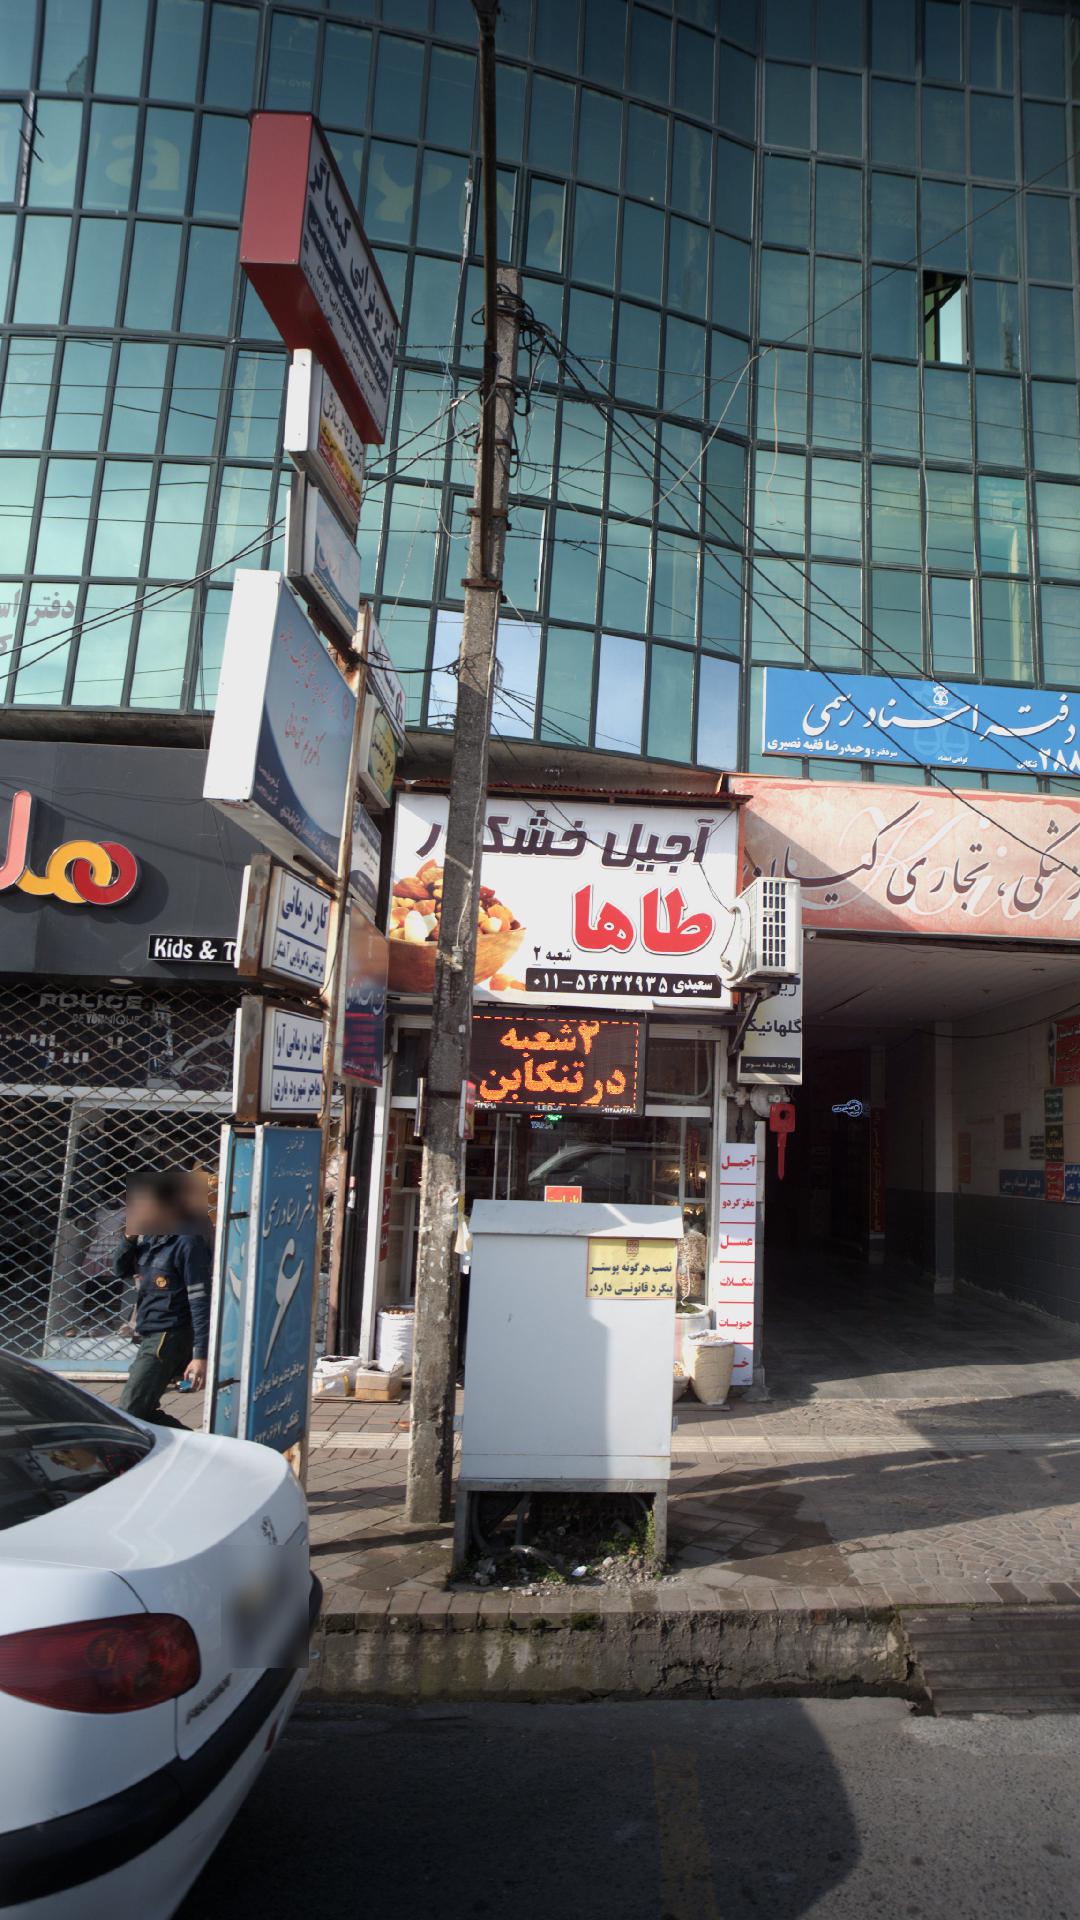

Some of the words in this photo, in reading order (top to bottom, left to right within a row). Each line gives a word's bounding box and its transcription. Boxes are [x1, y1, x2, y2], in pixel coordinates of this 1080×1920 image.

[27, 591, 75, 626] دفتر
[802, 692, 856, 737] رسمی
[863, 697, 979, 733] اسناد
[979, 693, 1076, 744] دفتر
[767, 737, 801, 751] نصیری
[415, 809, 588, 858] خشکر
[601, 818, 716, 873] آجیل
[886, 843, 990, 911] تجاری
[282, 886, 314, 929] درمانی
[314, 904, 328, 934] کار
[573, 884, 713, 953] طاها
[154, 938, 193, 959] Kids
[199, 940, 218, 960] &
[545, 948, 572, 965] شعبه
[672, 979, 713, 995] سعیدی
[39, 993, 143, 1010] POLICE
[500, 1024, 576, 1051] شعبه
[479, 1053, 585, 1101] تنکابن
[583, 1069, 627, 1105] در
[721, 1154, 757, 1171] آجیل
[720, 1235, 753, 1249] عسل
[589, 1262, 620, 1275] پوستر
[640, 1264, 650, 1275] هر
[653, 1261, 672, 1275] نصب
[614, 1281, 649, 1295] قانونی
[719, 1277, 754, 1287] شکلات
[718, 1318, 753, 1330] حبوبات
